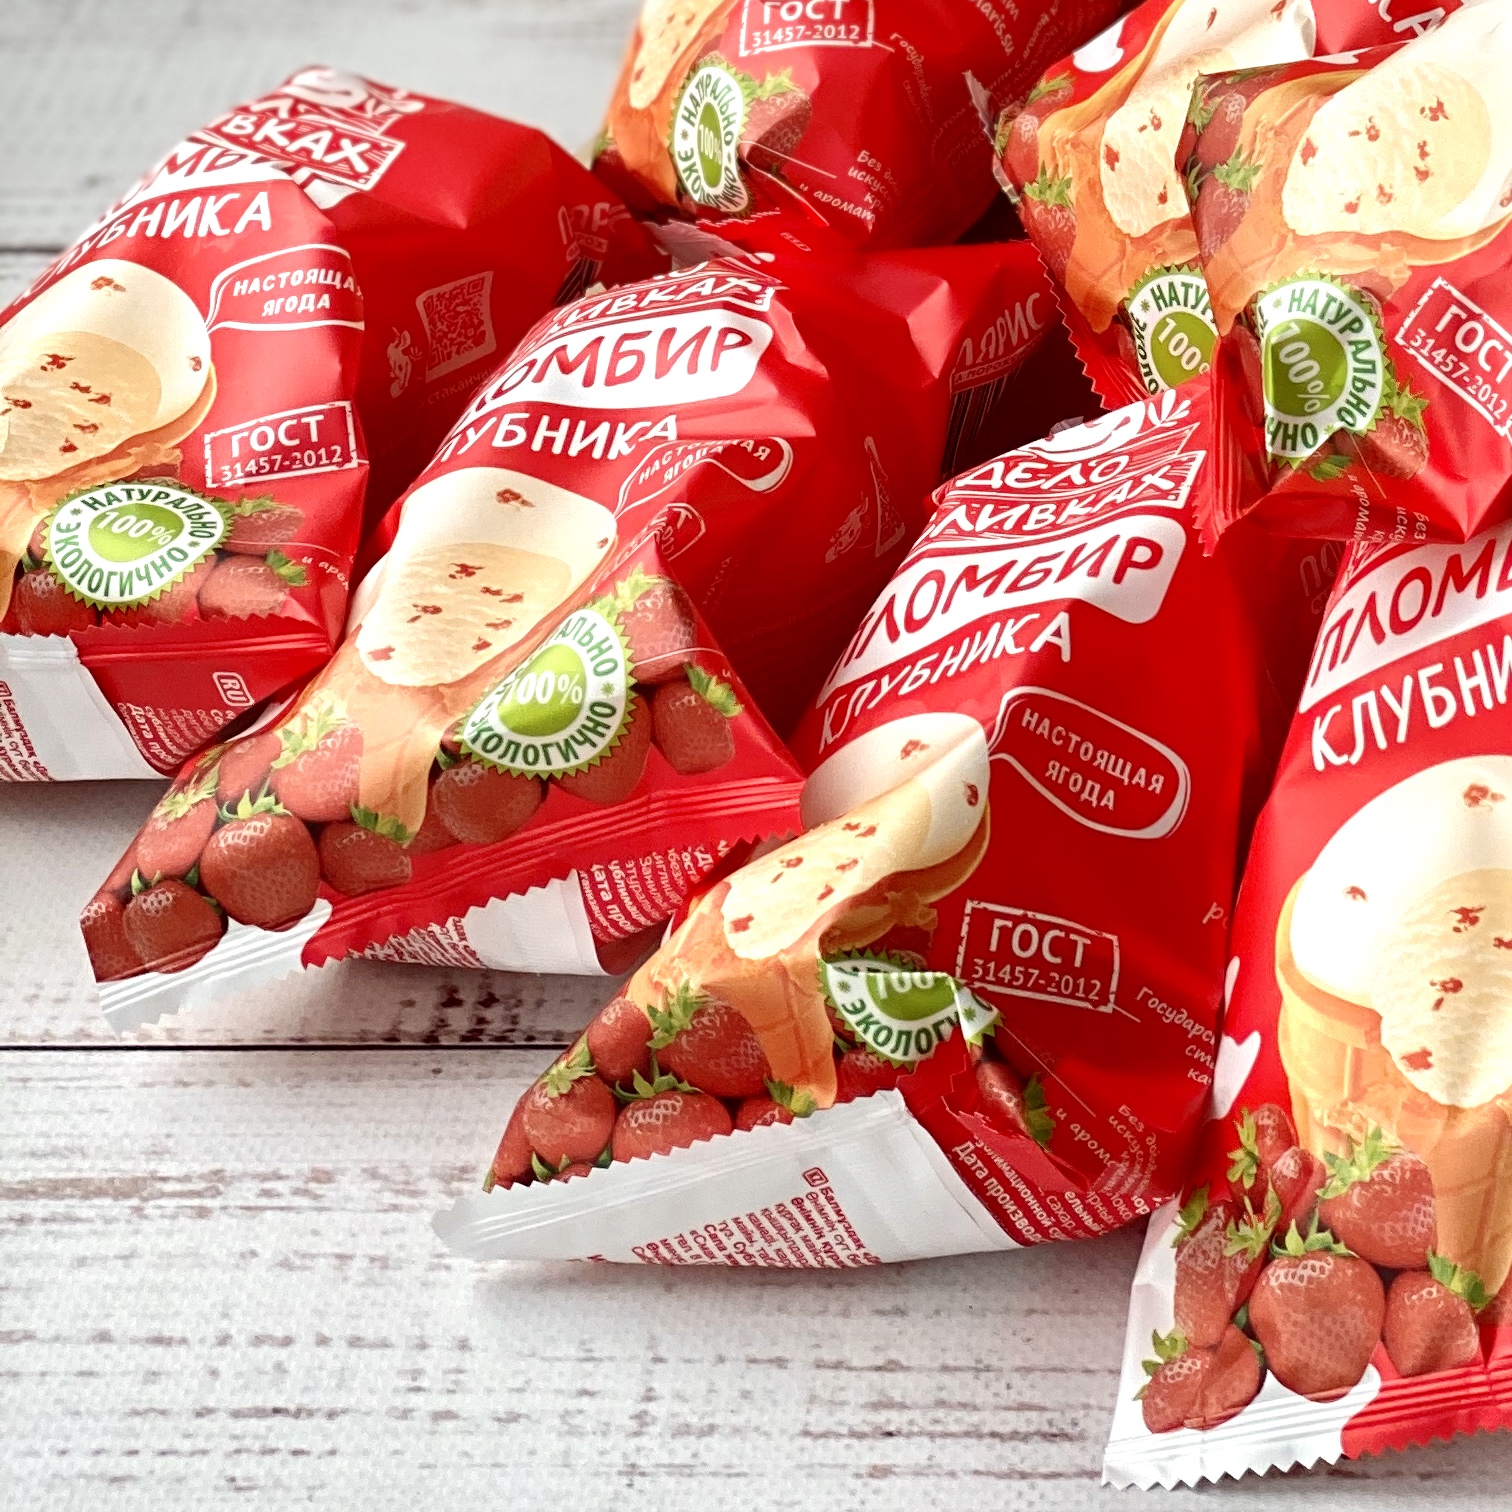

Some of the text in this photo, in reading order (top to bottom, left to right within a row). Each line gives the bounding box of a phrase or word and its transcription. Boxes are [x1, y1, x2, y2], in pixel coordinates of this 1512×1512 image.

[751, 24, 860, 49] 31457-2012
[681, 72, 738, 147] НАТУРАЛЬНО
[218, 113, 372, 173] ВКАХ
[698, 124, 723, 166] 100%
[232, 267, 364, 301] НАСТОЯЩА
[261, 293, 332, 317] ЯГОДА
[553, 276, 764, 329] ИВКАХ
[475, 326, 753, 413] ОМБИР
[1276, 322, 1332, 414] 100%
[1286, 287, 1379, 429] НАТУРАЛЬНО
[1408, 327, 1509, 421] 31457-2012
[230, 414, 325, 458] ГОСТ
[220, 445, 343, 482] 31457-2012
[954, 454, 1132, 490] ДЕЛО
[79, 485, 217, 541] НАТУРАЛЬНО
[96, 509, 174, 548] 100%
[55, 521, 191, 597] ЭКОЛОГИЧНО
[818, 610, 1073, 753] КЛУБНИКА
[1020, 707, 1166, 796] НАСТОЯЩАЯ
[1044, 759, 1117, 811] ЯГОДА
[988, 916, 1093, 968] ГОСТ
[972, 957, 1103, 1001] 31457-2012
[952, 1140, 1045, 1244] Дата производ
